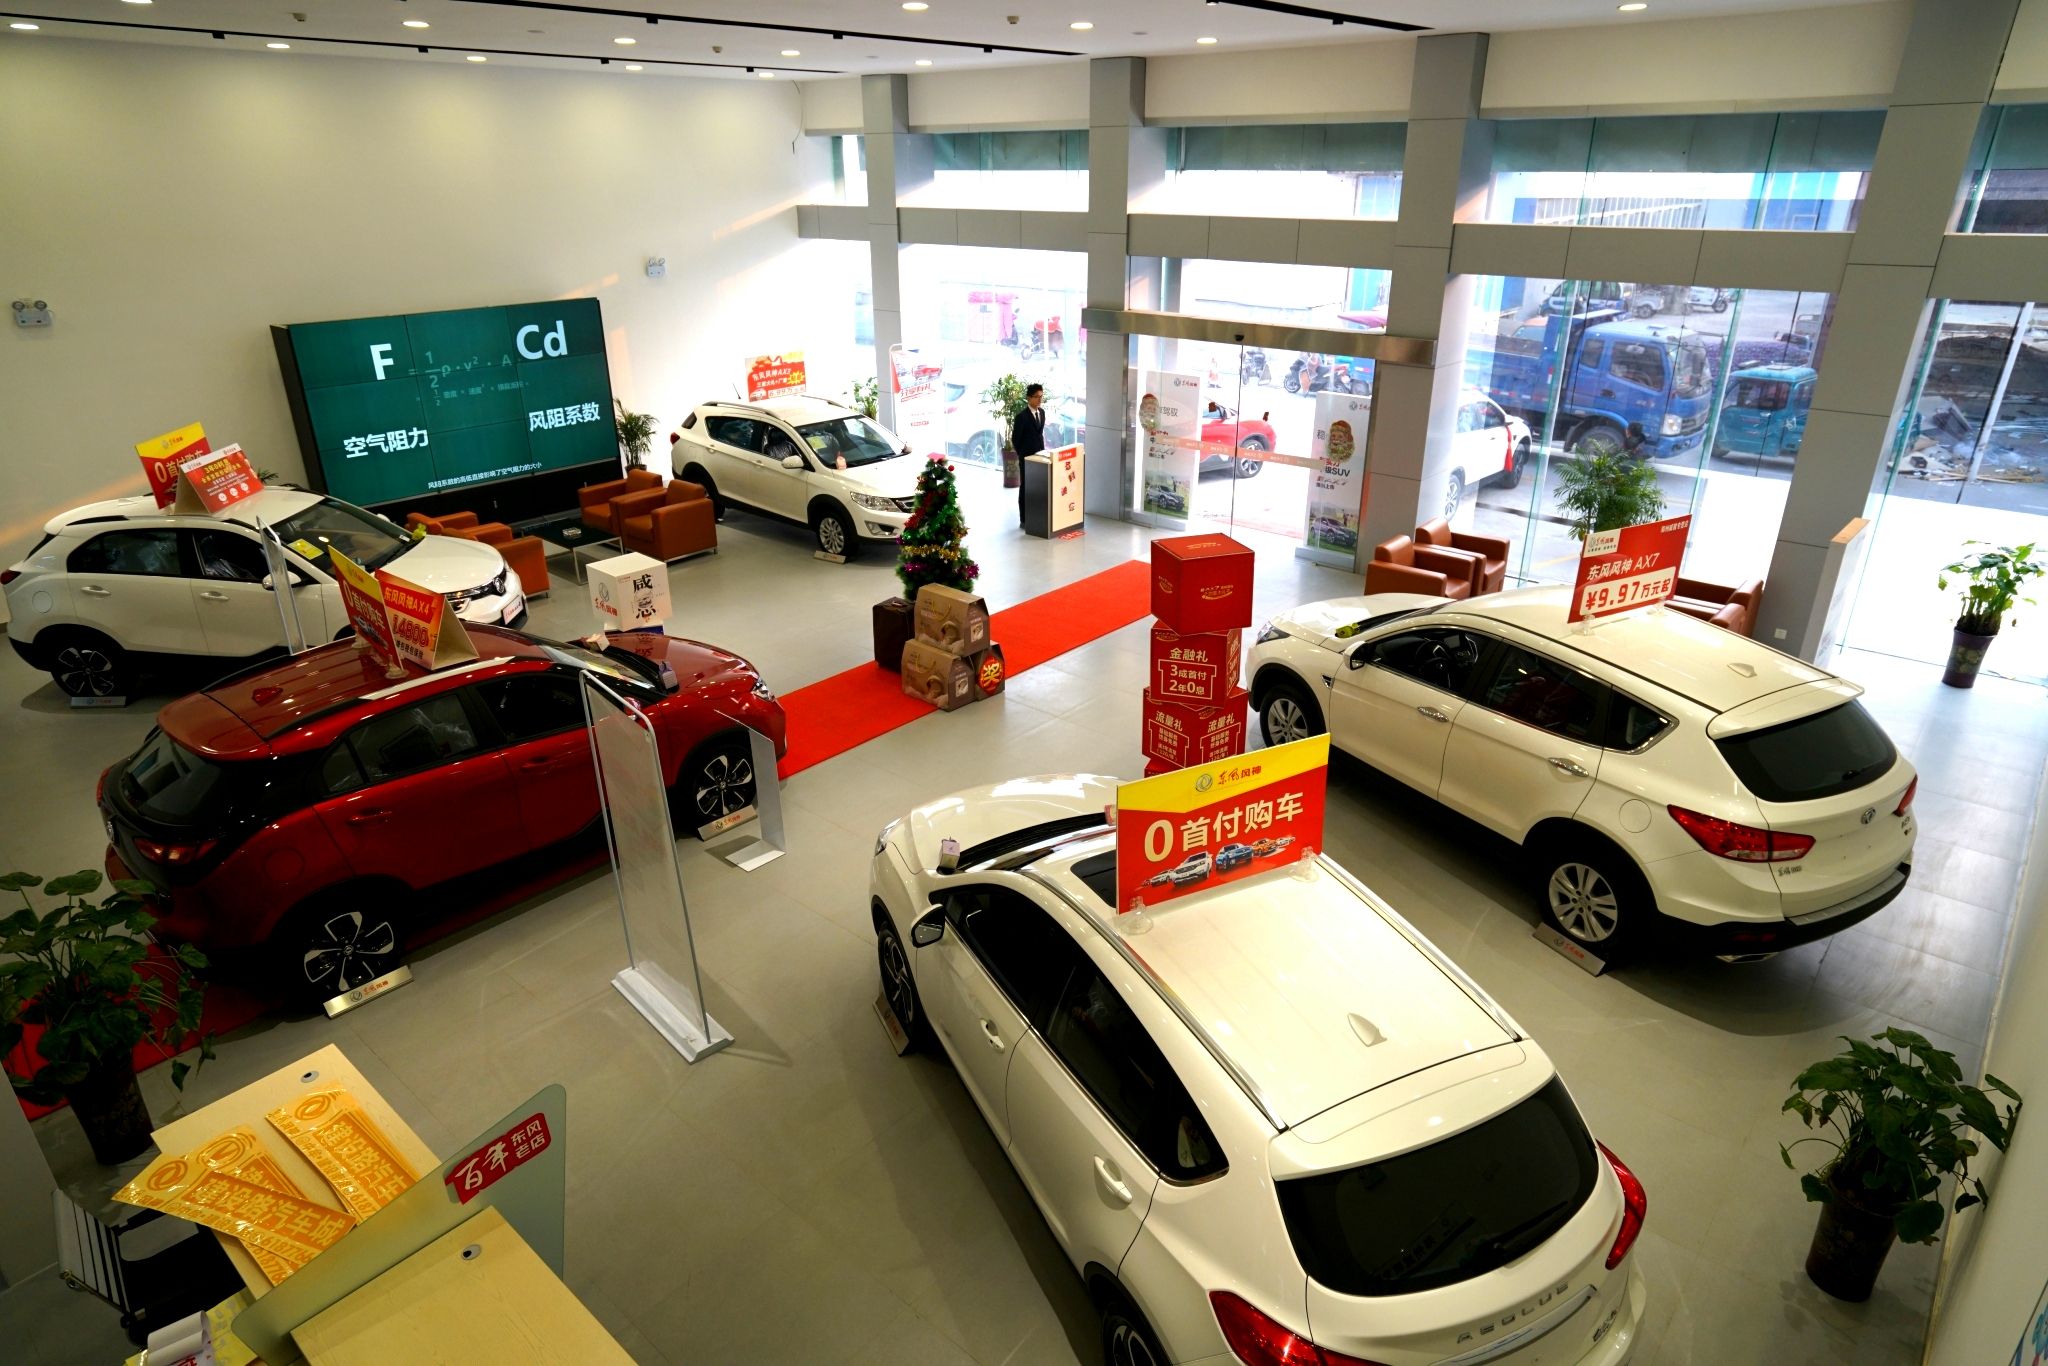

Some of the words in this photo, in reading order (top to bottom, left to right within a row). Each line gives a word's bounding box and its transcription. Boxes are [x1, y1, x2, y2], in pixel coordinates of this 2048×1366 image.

[369, 343, 394, 381] F
[516, 320, 568, 360] Cd
[528, 401, 600, 433] 风阻系数
[343, 426, 429, 459] 空气阻力
[1587, 559, 1633, 581] 东风风神
[1633, 553, 1660, 571] AX7
[1169, 647, 1209, 663] 金融礼
[1170, 664, 1207, 681] 3成首付
[1169, 679, 1205, 695] 2年0息
[1218, 765, 1262, 786] 东风风神
[1144, 792, 1304, 863] 0首付购车
[510, 1119, 542, 1147] 东风
[515, 1132, 546, 1159] 老店
[454, 1141, 509, 1190] 百年
[189, 1178, 346, 1246] 建设路汽车城
